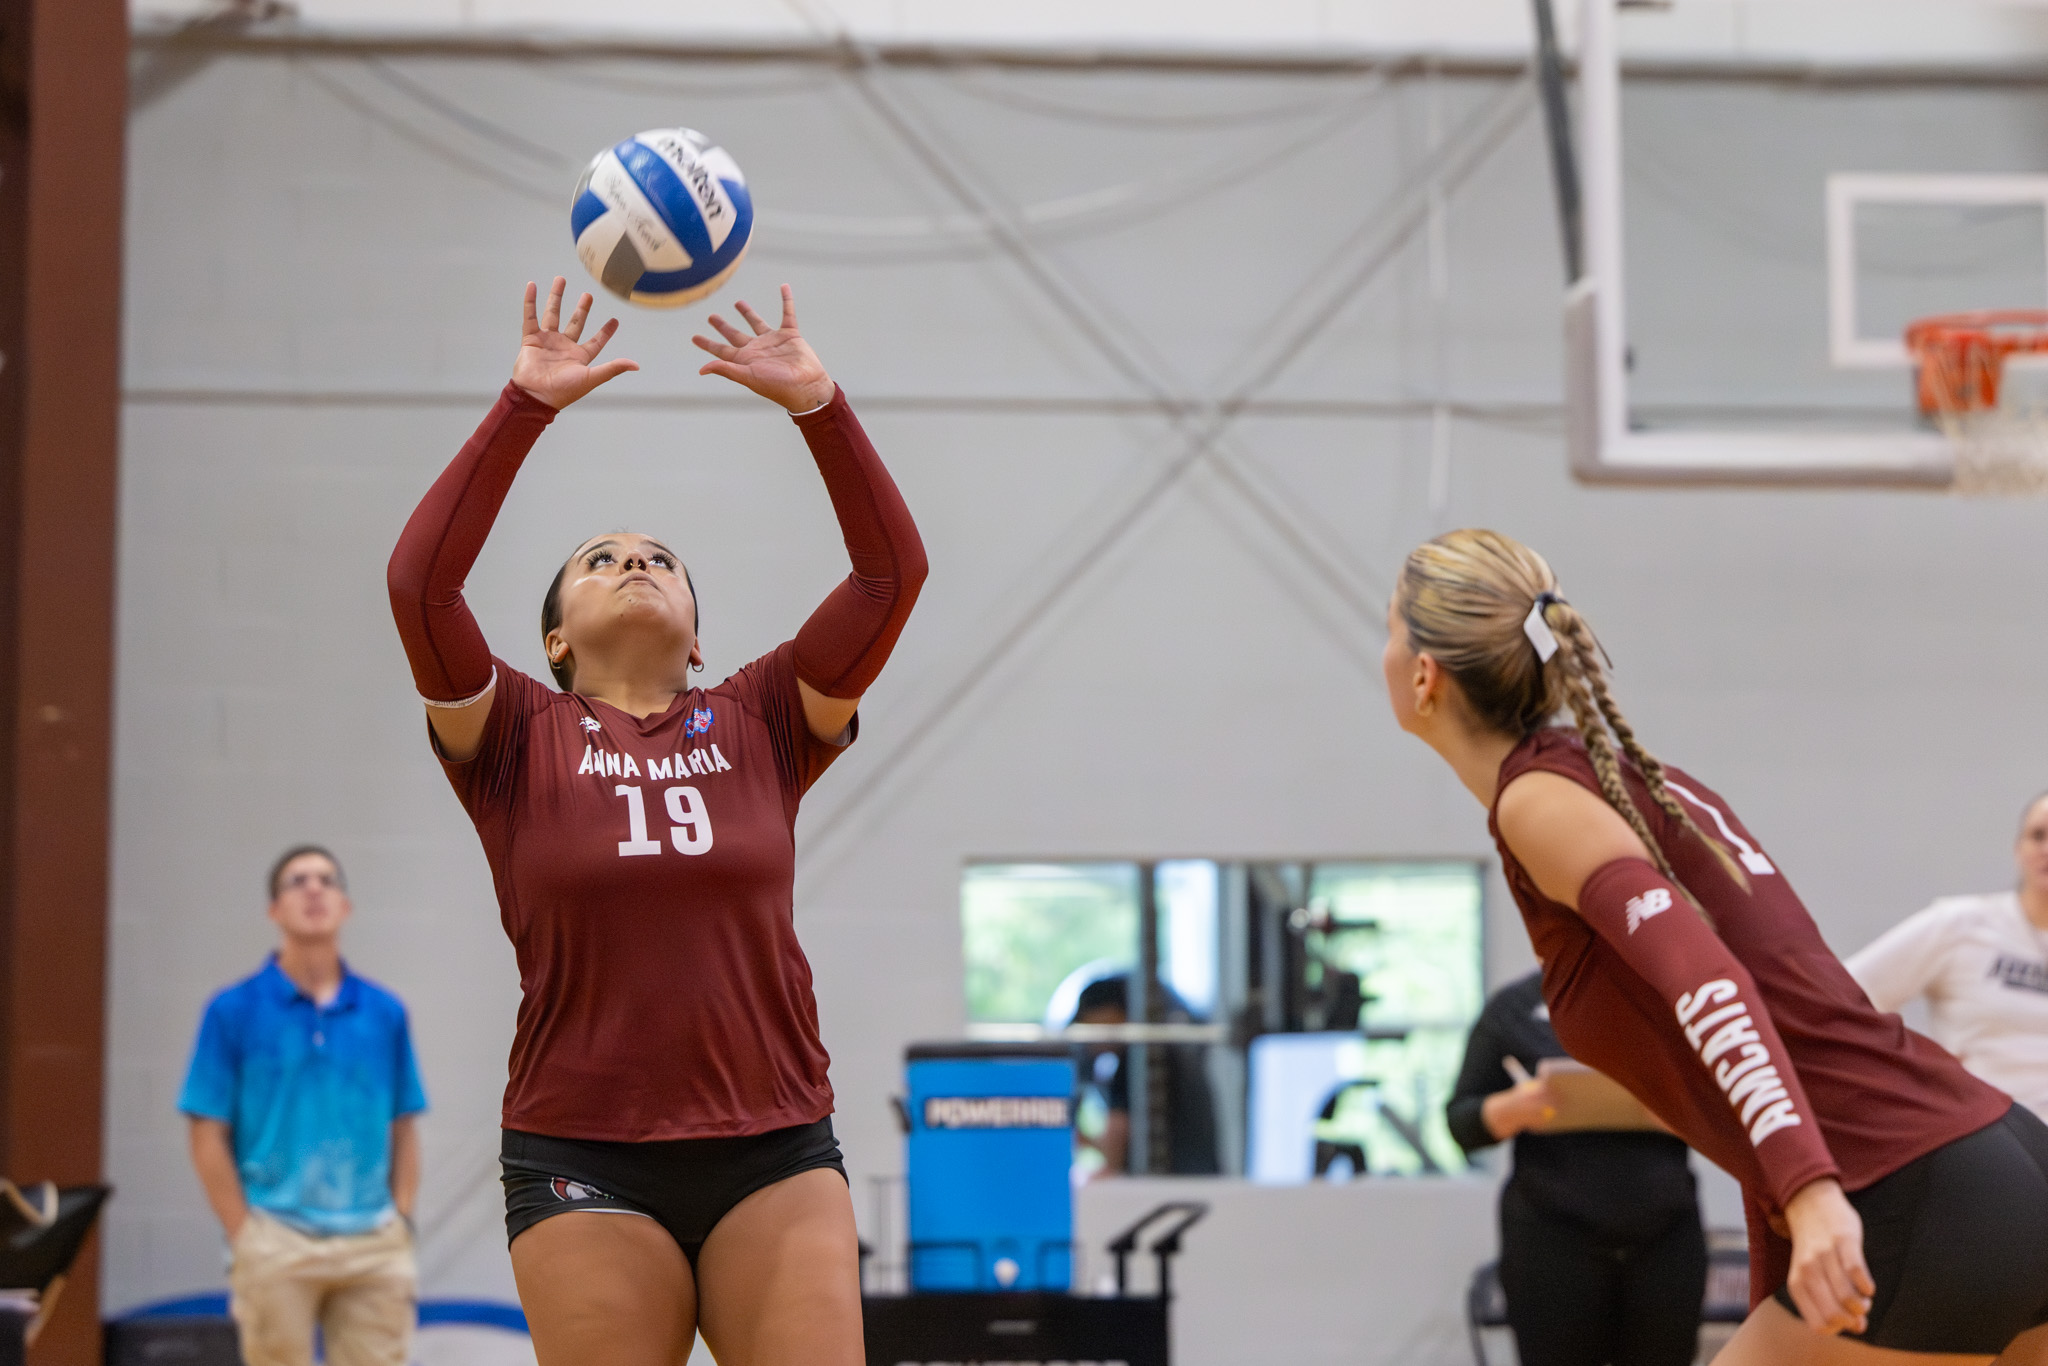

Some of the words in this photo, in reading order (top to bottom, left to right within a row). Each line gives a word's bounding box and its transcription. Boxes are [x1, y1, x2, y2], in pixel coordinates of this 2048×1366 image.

[577, 744, 642, 779] ANNA
[646, 743, 733, 781] MARIA
[614, 784, 714, 857] 19
[1674, 978, 1802, 1148] AMCATS
